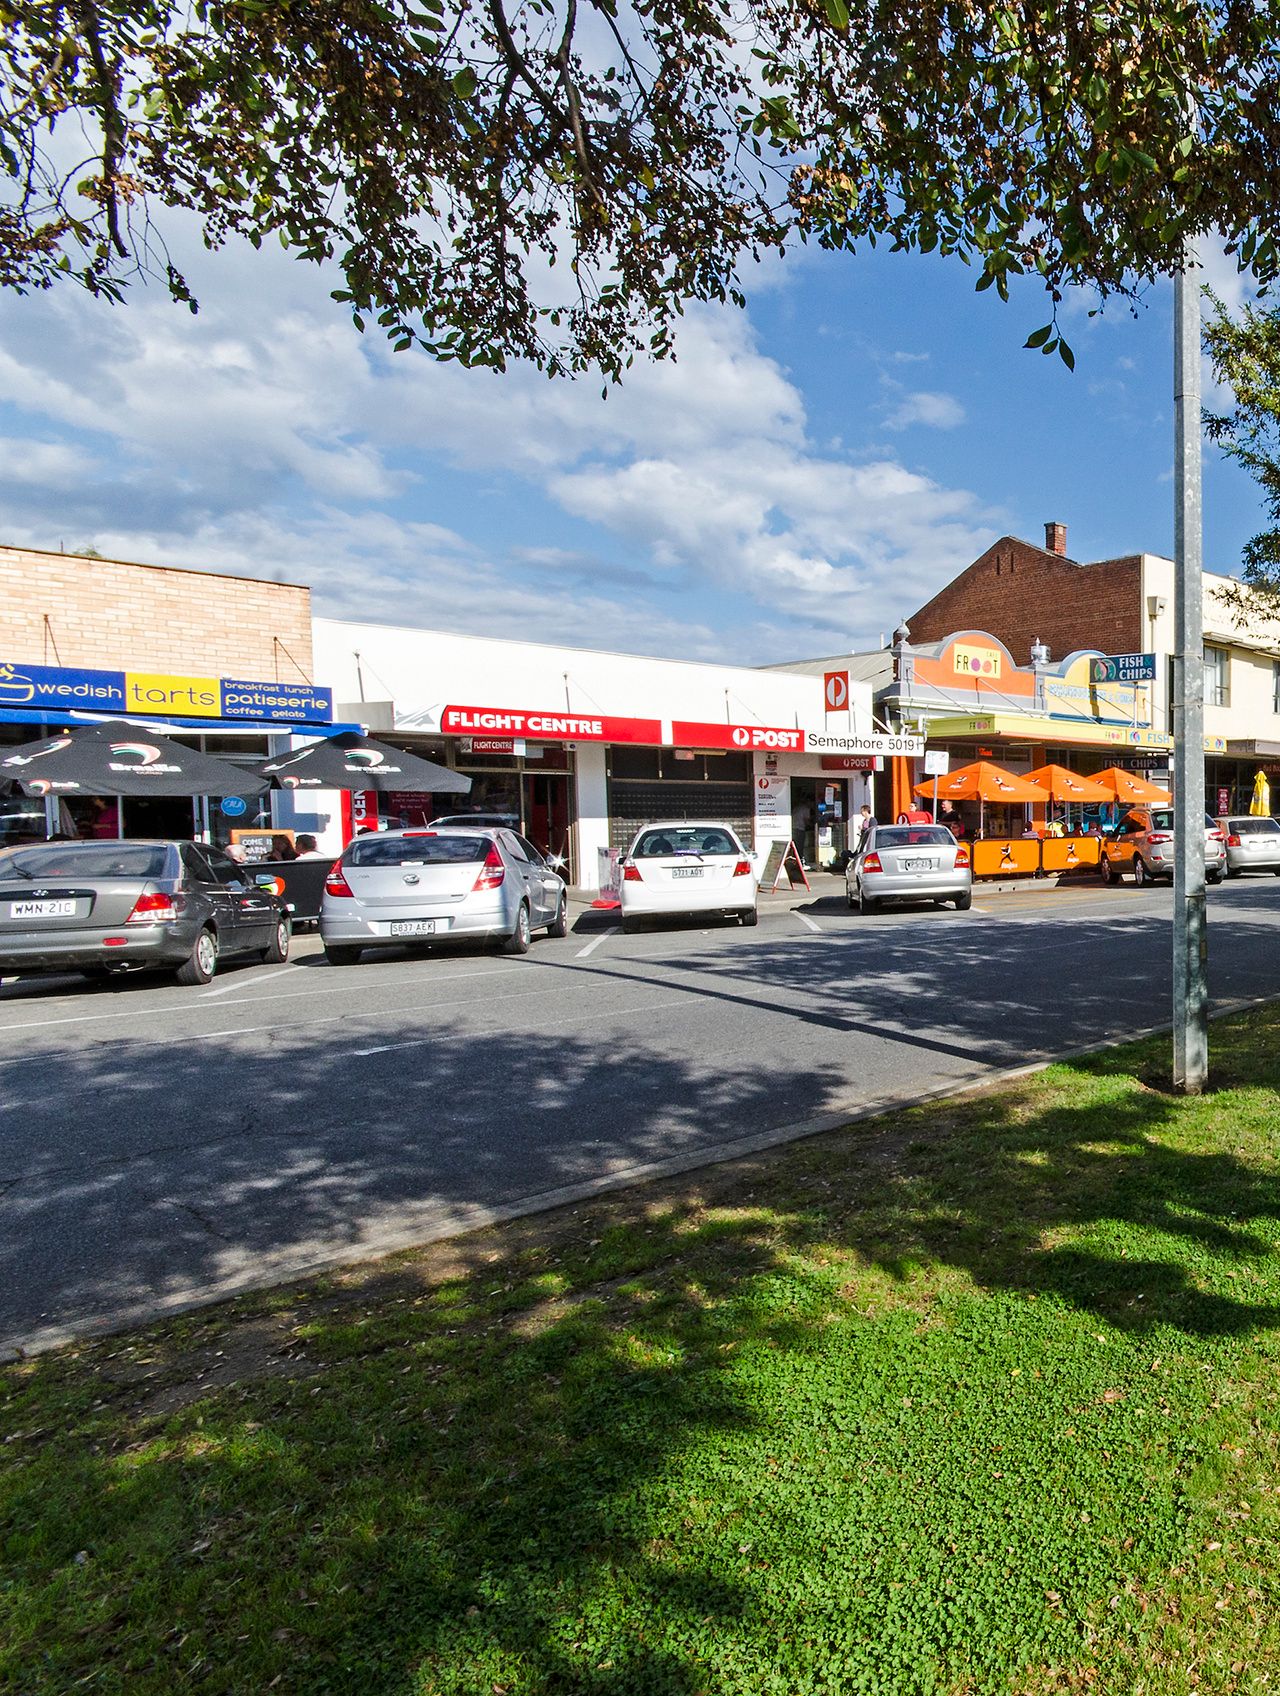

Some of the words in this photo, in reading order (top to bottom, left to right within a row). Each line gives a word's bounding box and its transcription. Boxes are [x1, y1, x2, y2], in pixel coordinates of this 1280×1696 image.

[1119, 656, 1144, 669] FISH
[1119, 668, 1153, 681] CHIPS
[132, 683, 215, 706] tarts
[224, 681, 280, 692] breakfast
[284, 686, 314, 695] lunch
[225, 693, 329, 710] patisserie
[225, 707, 264, 716] coffee
[271, 710, 306, 719] gelato
[448, 711, 525, 730] FLIGHT
[527, 717, 603, 735] CENTRE
[752, 729, 800, 748] POST
[808, 733, 883, 751] Semaphore
[888, 738, 915, 751] 5019
[1147, 732, 1170, 744] FISH
[473, 740, 492, 750] FLIGHT
[492, 741, 513, 750] CENTRE
[850, 758, 870, 768] POST
[1130, 758, 1158, 769] CHIPS
[15, 903, 43, 914] WMN
[416, 921, 434, 931] AEK
